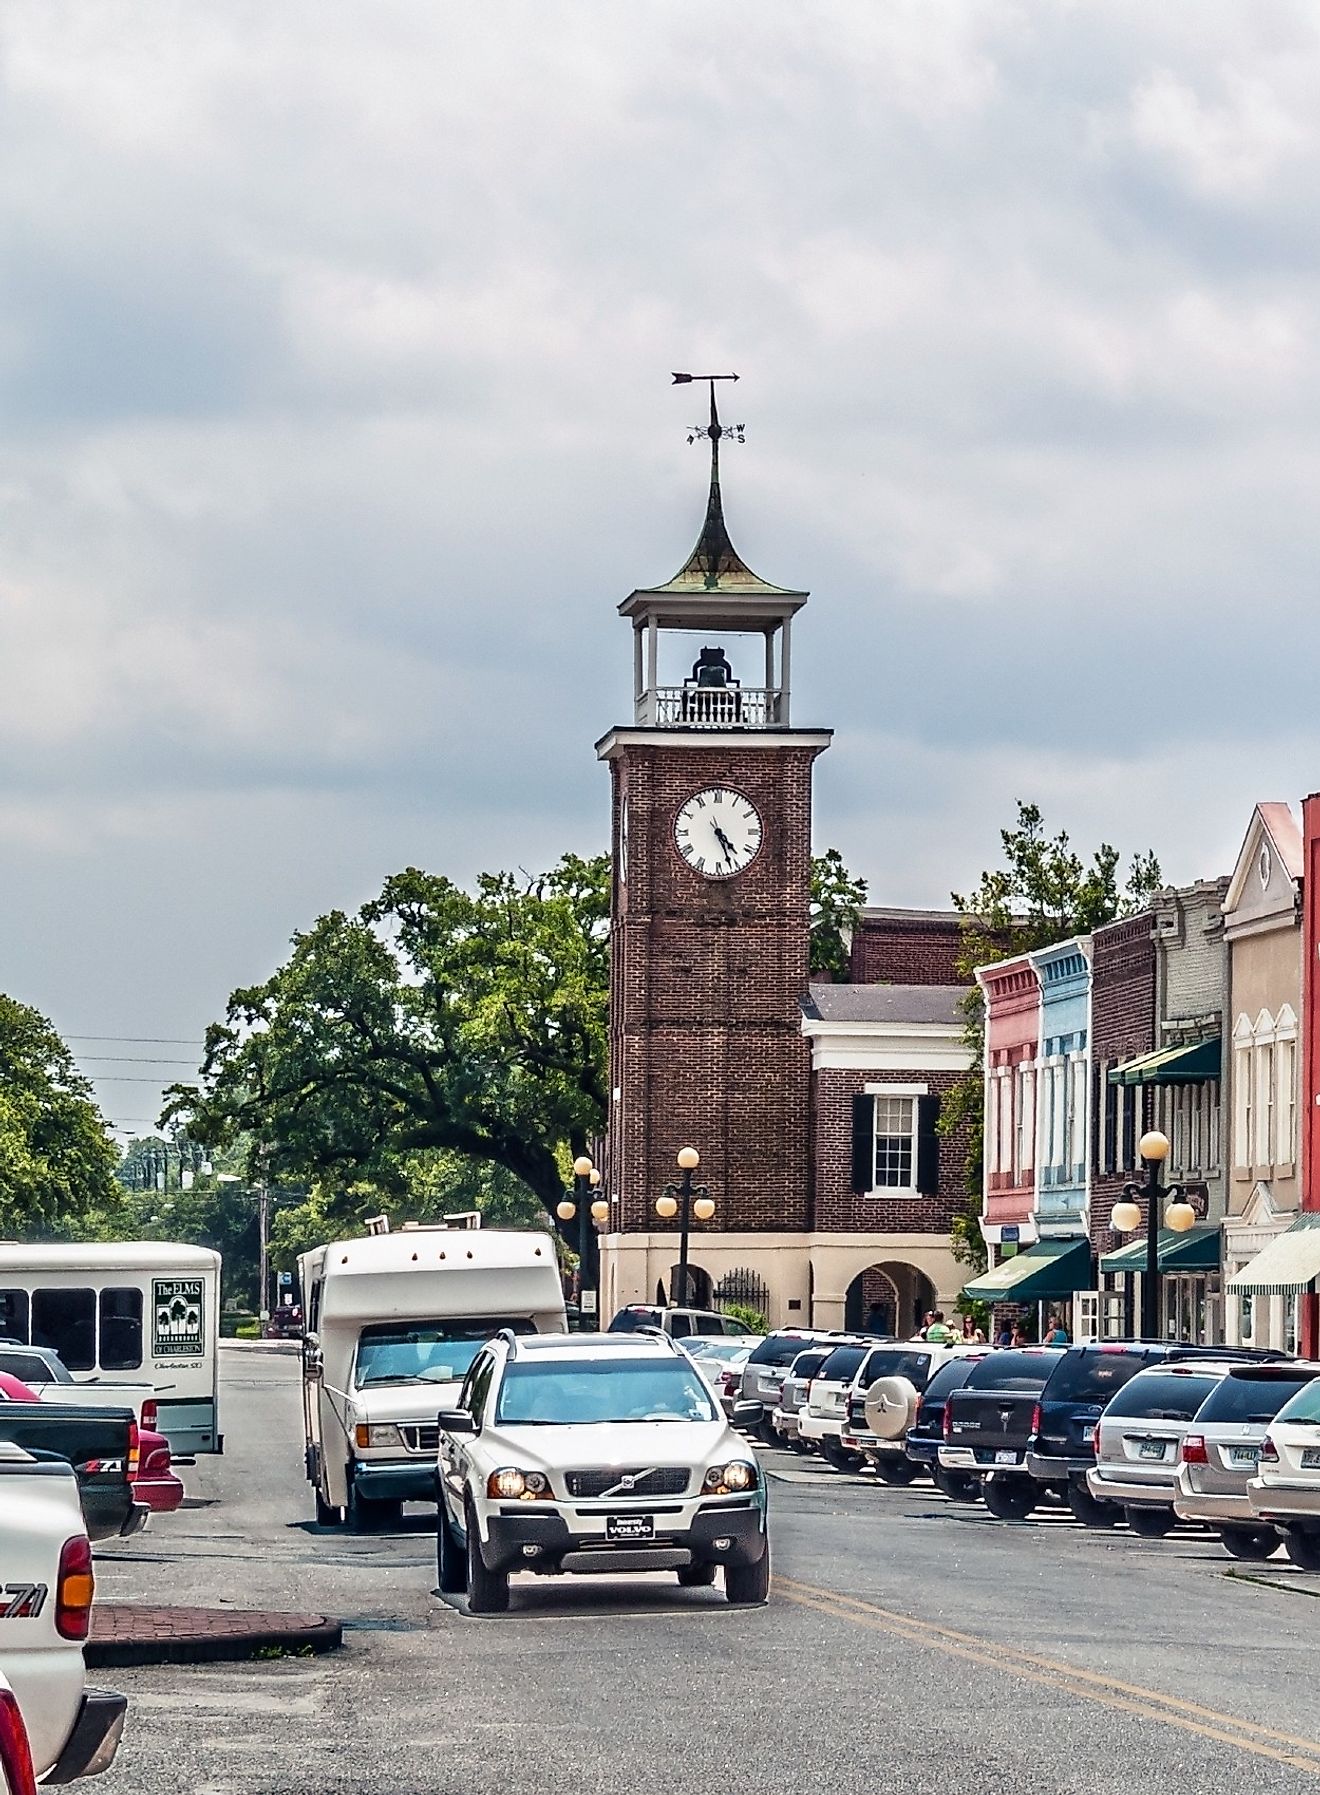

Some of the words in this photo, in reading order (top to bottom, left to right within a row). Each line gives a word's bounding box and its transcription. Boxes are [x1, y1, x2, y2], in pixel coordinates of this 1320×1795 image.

[738, 434, 746, 443] S
[158, 1283, 172, 1295] The
[173, 1282, 200, 1295] ELMS
[86, 1460, 122, 1472] Z71
[609, 1526, 652, 1534] VOLVO
[0, 1583, 48, 1618] 71
